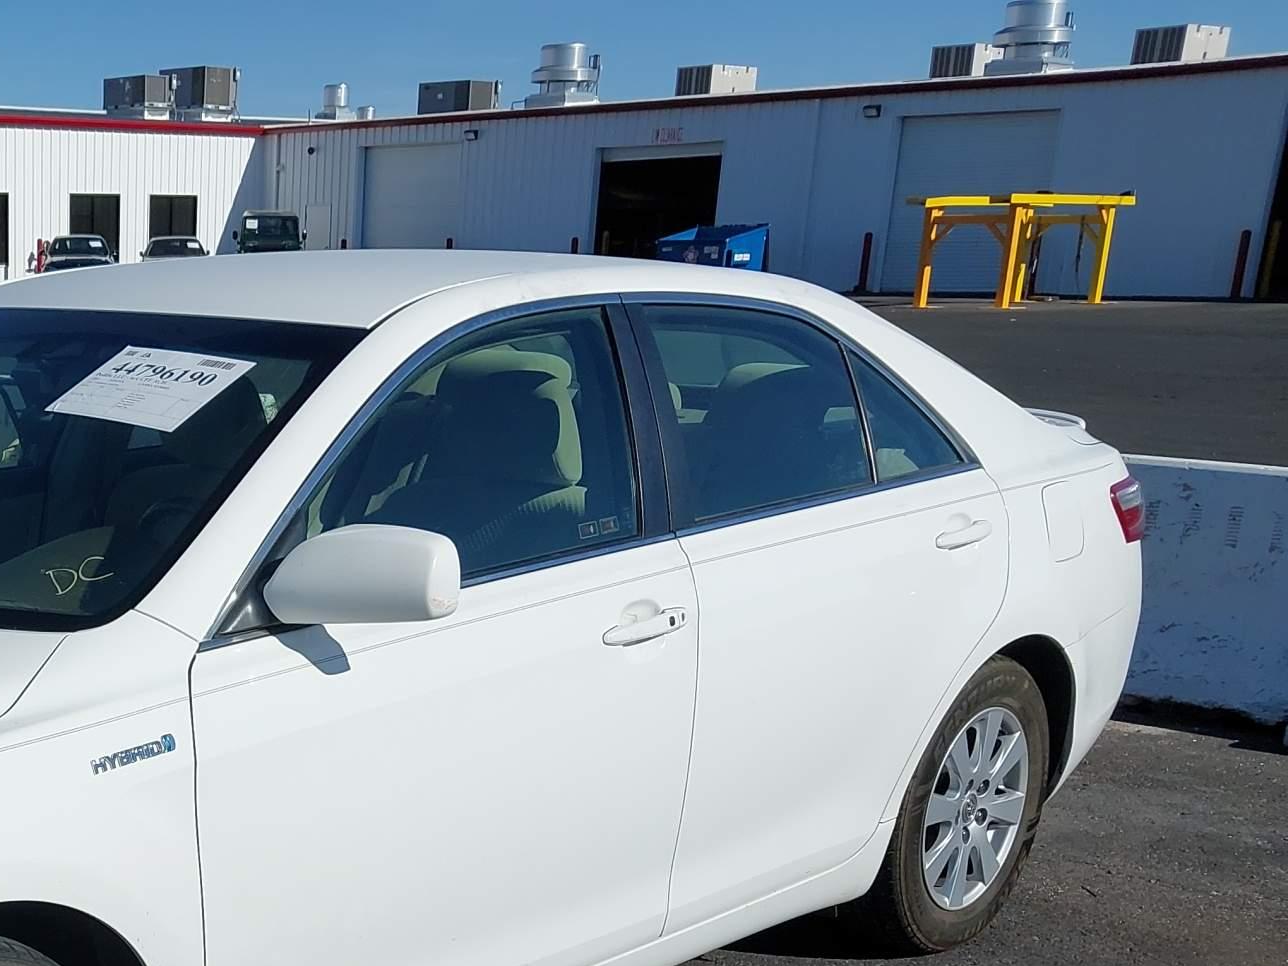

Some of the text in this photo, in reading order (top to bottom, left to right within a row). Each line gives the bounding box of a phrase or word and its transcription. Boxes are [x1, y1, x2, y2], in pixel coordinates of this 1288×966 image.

[111, 361, 219, 387] 44796190
[45, 556, 115, 596] DC
[90, 740, 163, 776] HYBRID
